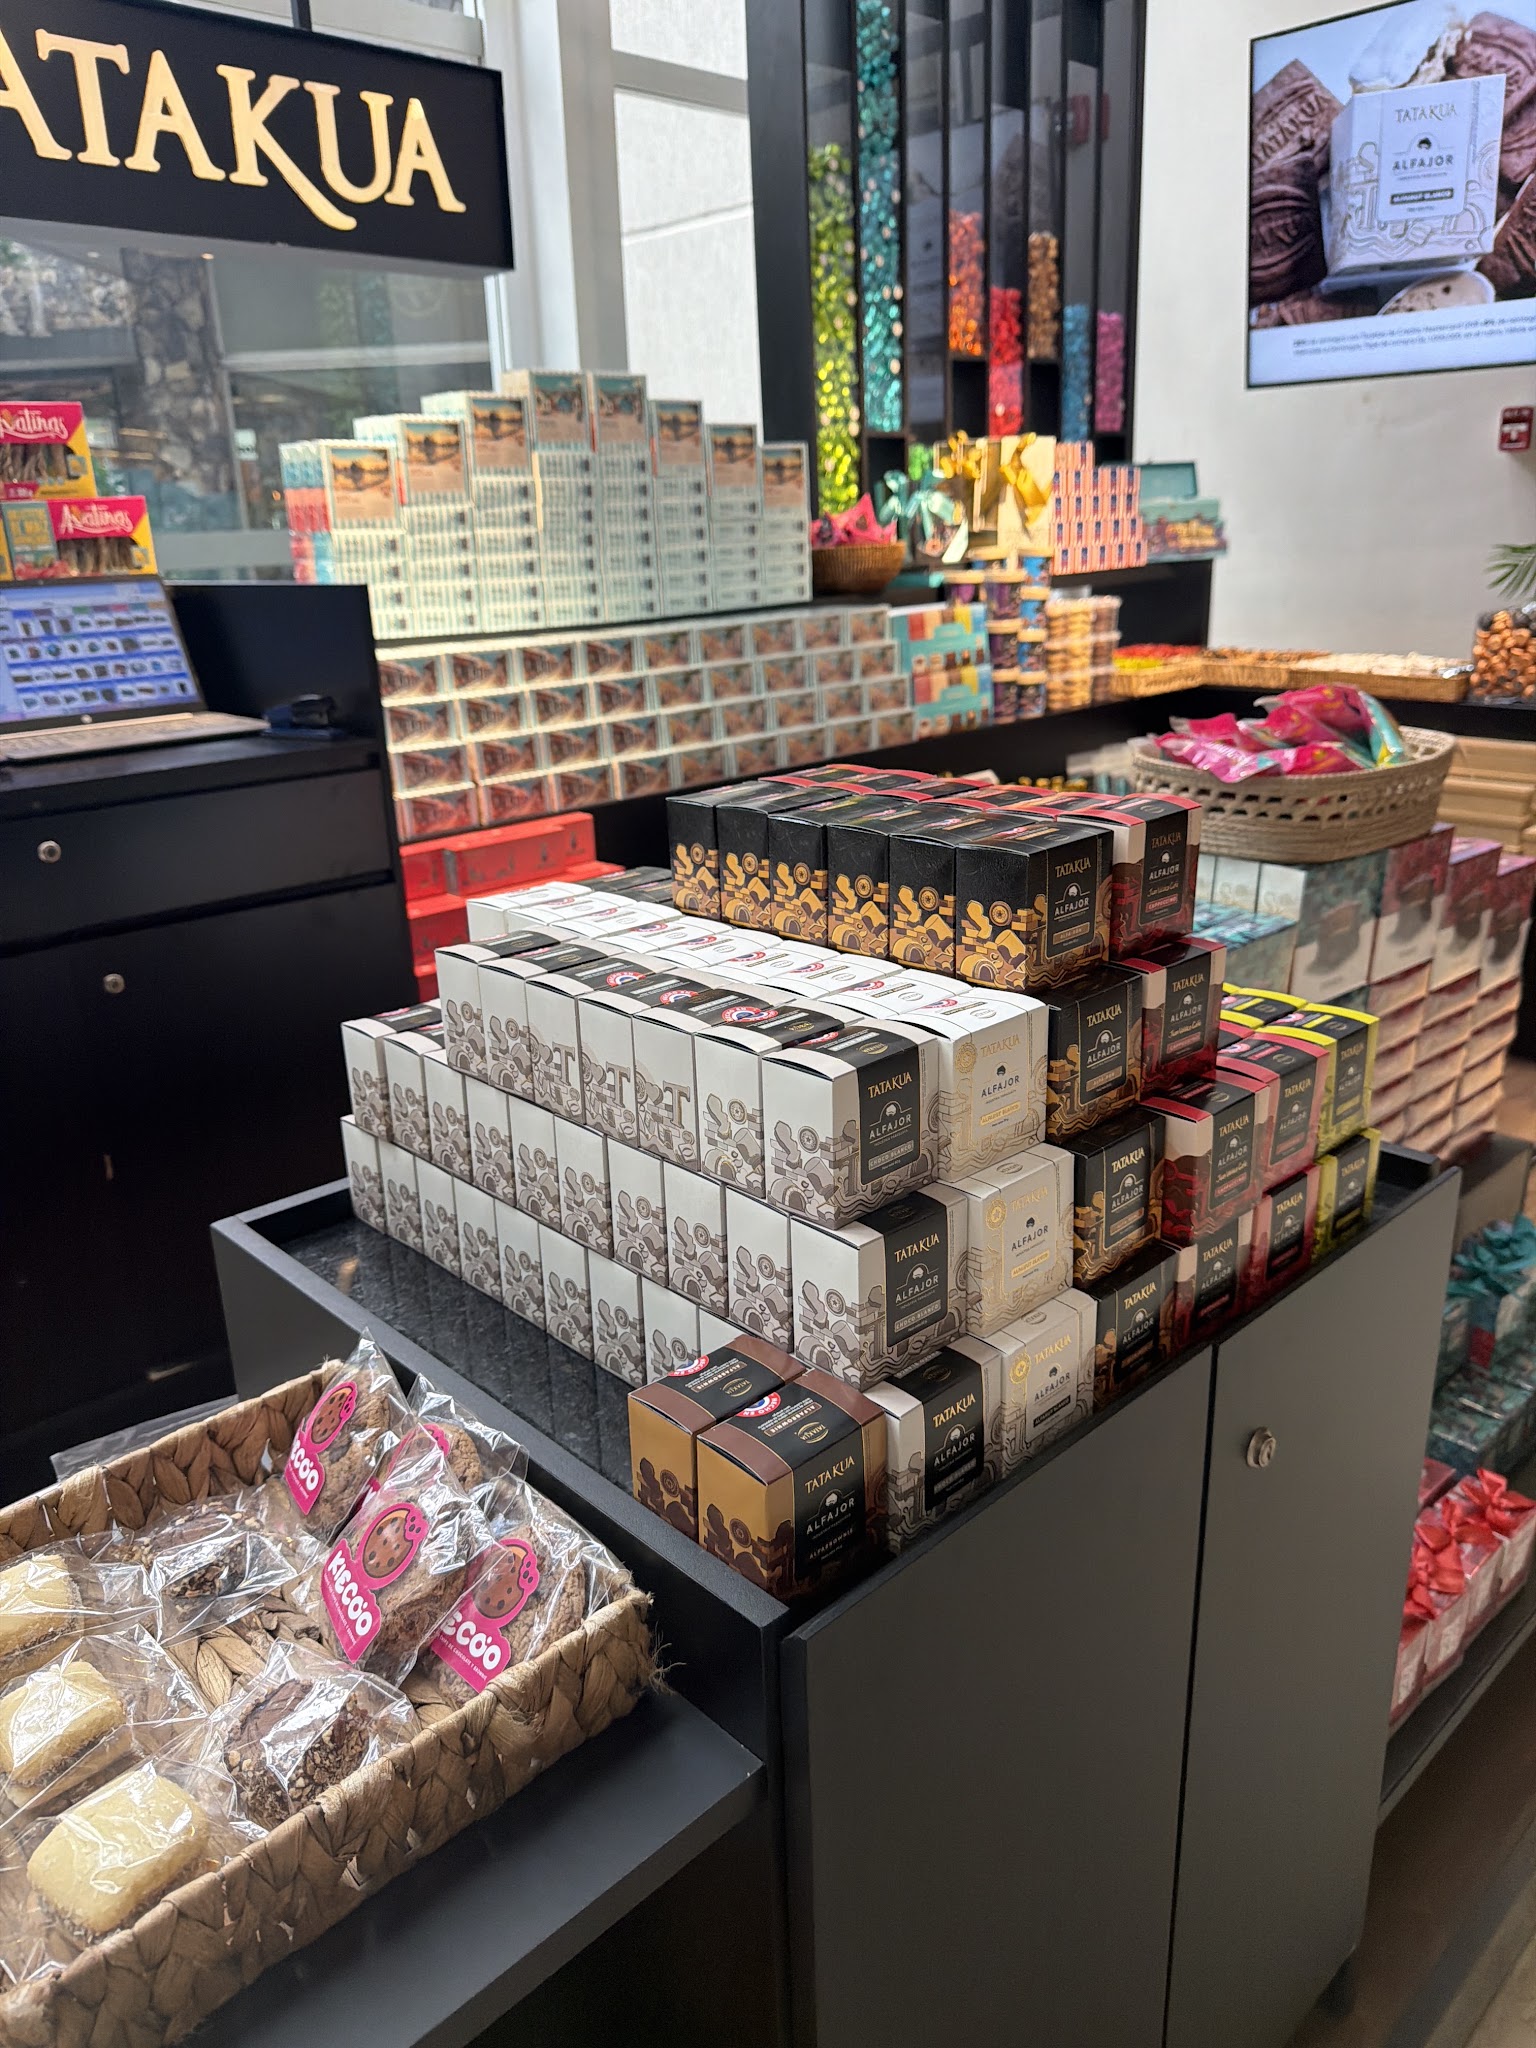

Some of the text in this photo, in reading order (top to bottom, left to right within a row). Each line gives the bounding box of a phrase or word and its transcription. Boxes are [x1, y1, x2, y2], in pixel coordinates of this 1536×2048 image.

[1394, 103, 1457, 124] TATAKUA
[1391, 153, 1454, 171] ALFAJOR
[1055, 857, 1092, 878] TATAKUA
[1149, 863, 1180, 881] ALFAJOR
[1054, 897, 1090, 917] ALFAJOR
[1172, 973, 1205, 993] TATAKUA
[1087, 1003, 1122, 1027] TATAKUA
[1170, 1004, 1203, 1023] ALFAJOR
[981, 1034, 1021, 1058] TATAKUA
[1087, 1042, 1122, 1064] ALFAJOR
[868, 1072, 912, 1099] TATAKUA
[981, 1075, 1020, 1098] ALFAJOR
[1285, 1078, 1311, 1098] TATAKUA
[869, 1114, 912, 1140] ALFAJOR
[1219, 1114, 1249, 1137] TATAKUA
[870, 1154, 890, 1167] CHOCO
[890, 1143, 912, 1159] BLANCO
[1112, 1147, 1145, 1173] TATAKUA
[1217, 1145, 1248, 1167] ALFAJOR
[1011, 1186, 1048, 1212] TATAKUA
[1111, 1184, 1144, 1209] ALFAJOR
[1276, 1192, 1303, 1215] TATAKUA
[894, 1232, 940, 1263] TATAKUA
[1011, 1225, 1048, 1251] ALFAJOR
[1203, 1238, 1233, 1262] TATAKUA
[895, 1275, 939, 1304] ALFAJOR
[1201, 1266, 1231, 1290] ALFAJOR
[1123, 1281, 1157, 1309] TATAKUA
[896, 1316, 917, 1331] CHOCO
[917, 1304, 940, 1319] BLANCO
[1122, 1317, 1154, 1344] ALFAJOR
[1035, 1333, 1072, 1364] TATAKUA
[698, 1362, 741, 1389] ALFABROWNIE
[1034, 1372, 1070, 1402] ALFAJOR
[771, 1404, 816, 1434] ALFABROWNIE
[932, 1392, 976, 1428] TATAKUA
[934, 1433, 976, 1466] ALFAJOR
[805, 1455, 855, 1494] TATAKUA
[806, 1498, 855, 1535] ALFAJOR
[809, 1527, 854, 1560] ALFABROWNIE
[453, 1647, 472, 1666] CHOCOLATE
